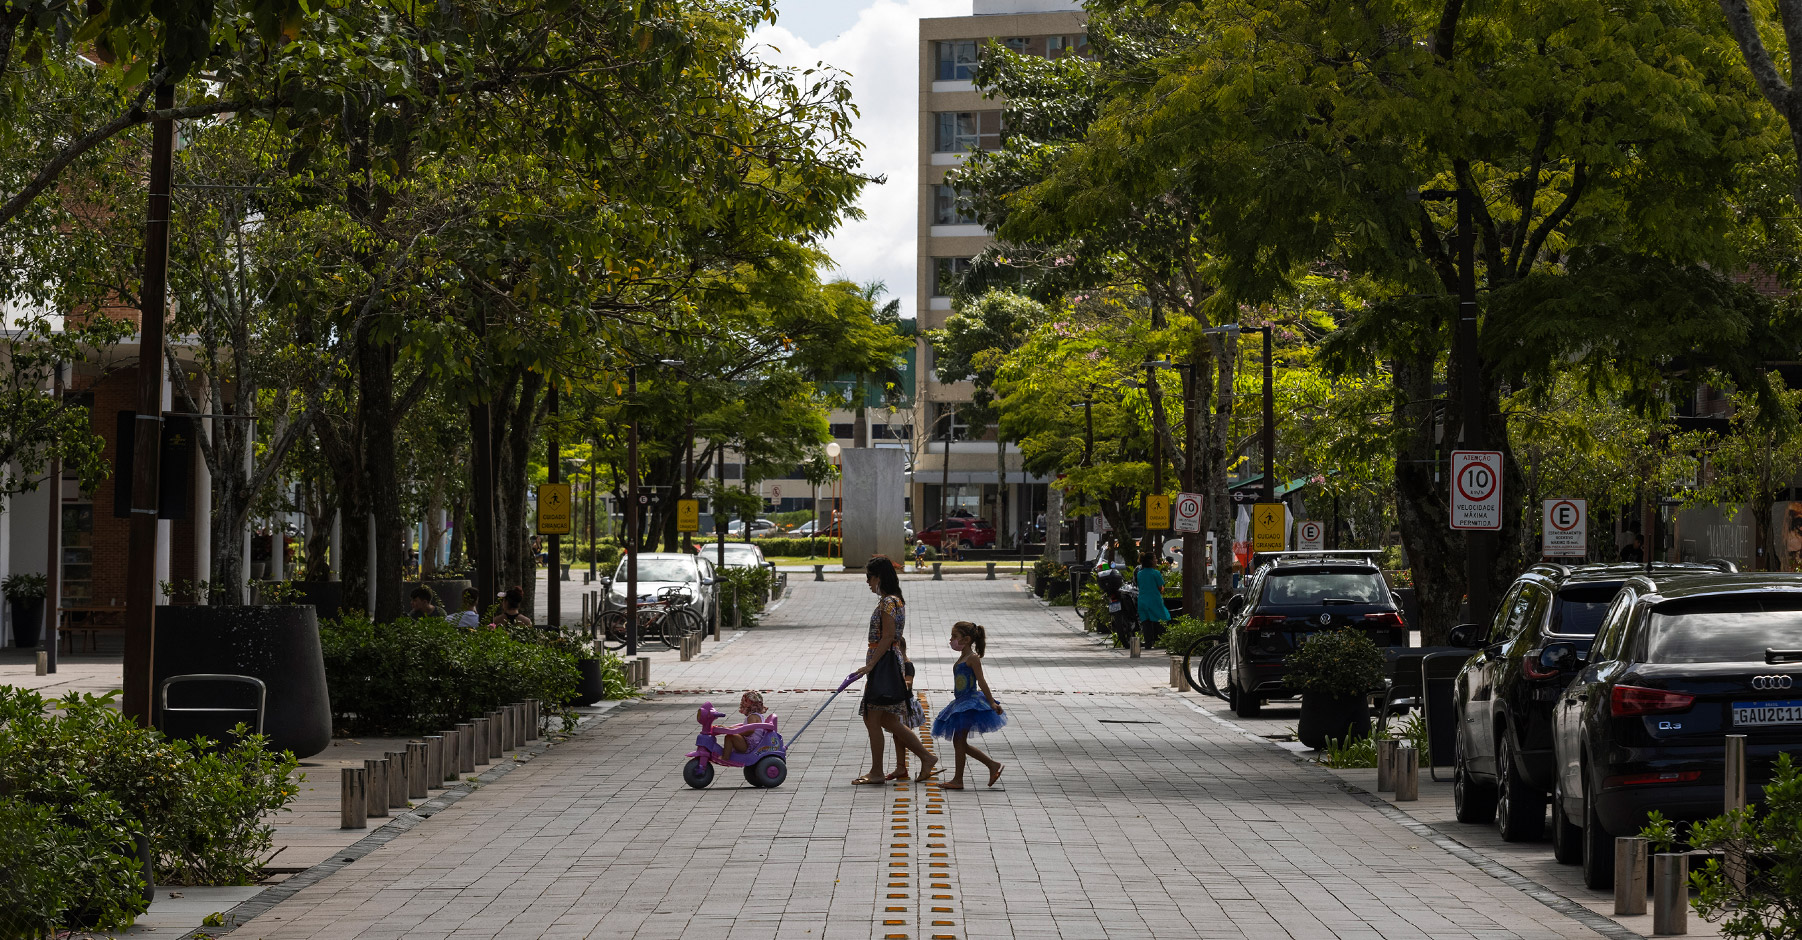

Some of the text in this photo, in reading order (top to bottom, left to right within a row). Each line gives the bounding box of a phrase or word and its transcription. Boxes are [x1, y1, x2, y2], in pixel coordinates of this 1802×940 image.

[1468, 470, 1488, 488] 10
[1184, 502, 1195, 512] 10
[1559, 508, 1570, 524] E
[1307, 527, 1314, 537] E
[1740, 707, 1802, 723] GAU2C11
[1658, 721, 1682, 730] Q3
